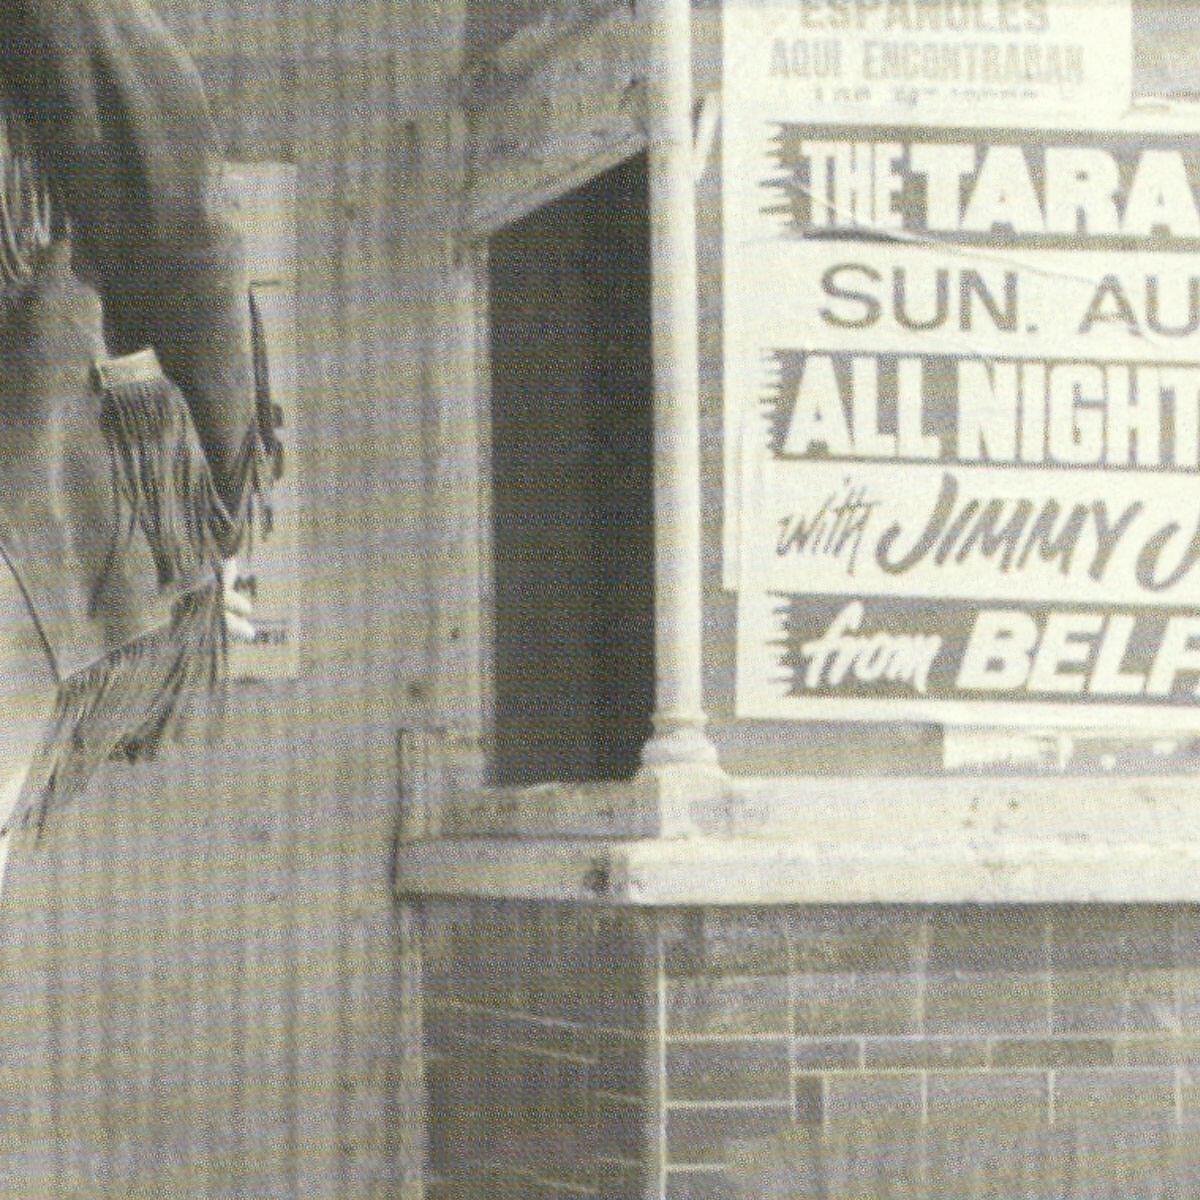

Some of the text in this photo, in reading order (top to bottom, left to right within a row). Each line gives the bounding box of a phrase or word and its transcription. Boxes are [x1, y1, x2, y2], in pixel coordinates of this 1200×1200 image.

[800, 141, 1200, 239] THE TARA
[816, 260, 1200, 338] SUN. AU
[782, 354, 1200, 467] ALL NIGHT
[776, 475, 882, 576] with
[875, 472, 1143, 582] JIMMY
[802, 603, 1200, 697] from BELF
